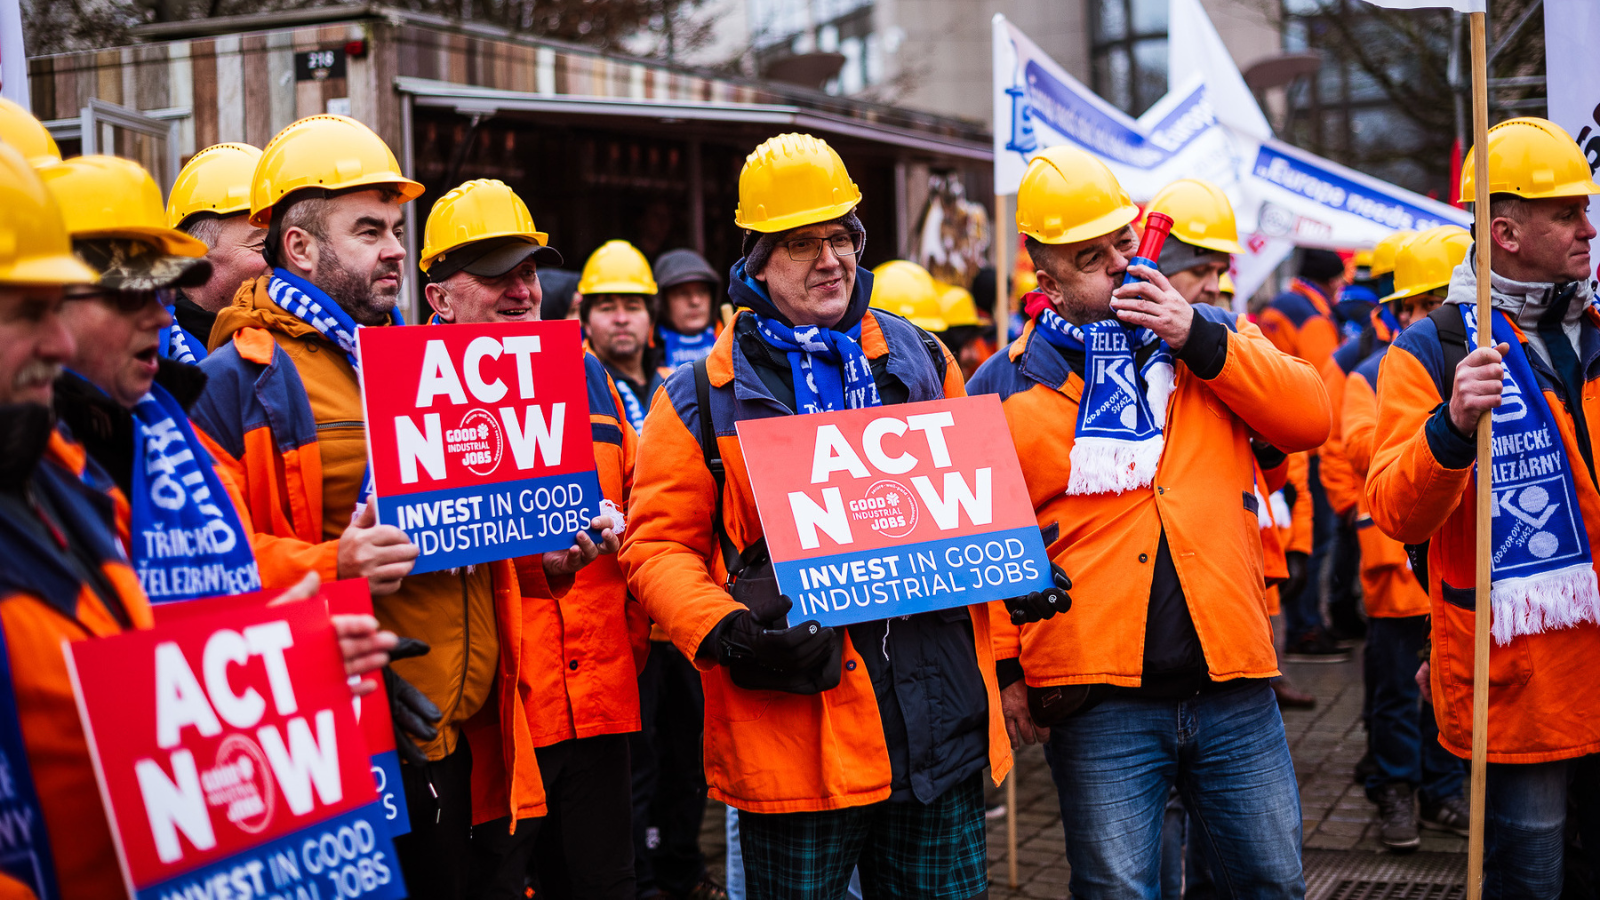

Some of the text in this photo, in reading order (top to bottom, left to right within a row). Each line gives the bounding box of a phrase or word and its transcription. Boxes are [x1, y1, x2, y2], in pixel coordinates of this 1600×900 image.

[1089, 327, 1130, 351] ŽELEZ
[415, 335, 542, 408] ACT
[1086, 387, 1124, 424] ODBOROVÝ
[1111, 395, 1132, 414] SVAZ
[394, 402, 566, 484] NOW
[446, 428, 477, 442] GOOD
[447, 441, 490, 453] INDUSTRIAL
[810, 411, 955, 484] ACT
[1492, 421, 1552, 457] ŘINECKÉ
[462, 450, 492, 466] JOBS
[1492, 450, 1561, 483] LEZÁRNY
[397, 483, 583, 531] INVEST IN GOOD
[787, 466, 993, 550] NOW
[849, 497, 886, 512] GOOD
[852, 507, 902, 520] INDUSTRIAL
[871, 515, 906, 530] JOBS
[411, 508, 591, 557] DUSTRIAL JOBS
[1493, 519, 1524, 563] ODBOROVÝ
[1515, 526, 1534, 547] SVAZ
[798, 537, 1025, 590] INVEST IN GOOD
[798, 559, 1039, 616] INDUSTRIAL JOBS
[154, 620, 299, 750] ACT
[134, 708, 343, 865] NOW
[268, 847, 302, 889] IN
[302, 819, 376, 874] GOOD
[328, 851, 391, 900] JOBS
